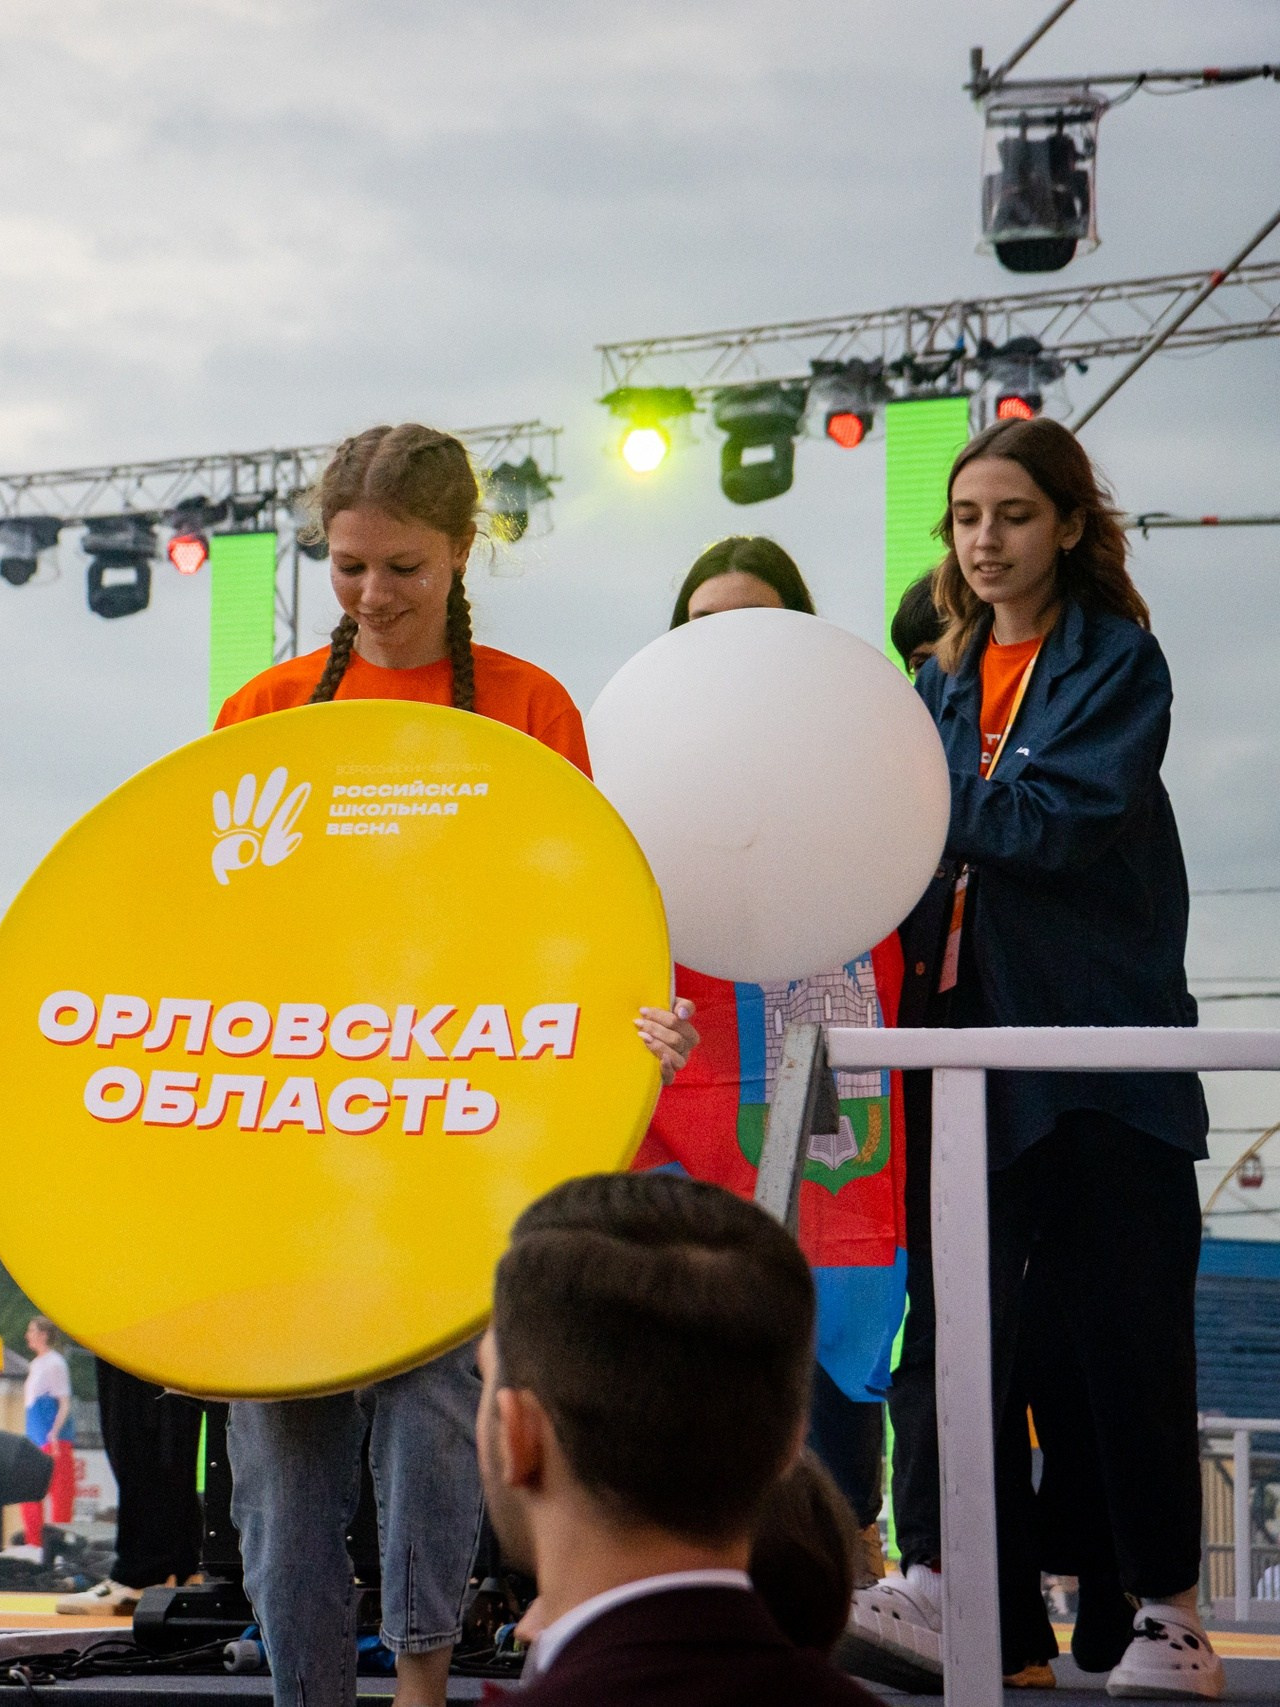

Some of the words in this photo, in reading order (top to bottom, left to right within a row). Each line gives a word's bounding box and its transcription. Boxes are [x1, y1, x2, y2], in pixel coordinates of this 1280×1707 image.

[332, 780, 489, 798] РОССИЙСКАЯ
[329, 802, 459, 817] ШКОЛЬНАЯ
[325, 822, 400, 836] ВЕСНА
[38, 990, 581, 1061] ОРЛОВСКАЯ
[83, 1065, 500, 1136] ОБЛАСТЬ
